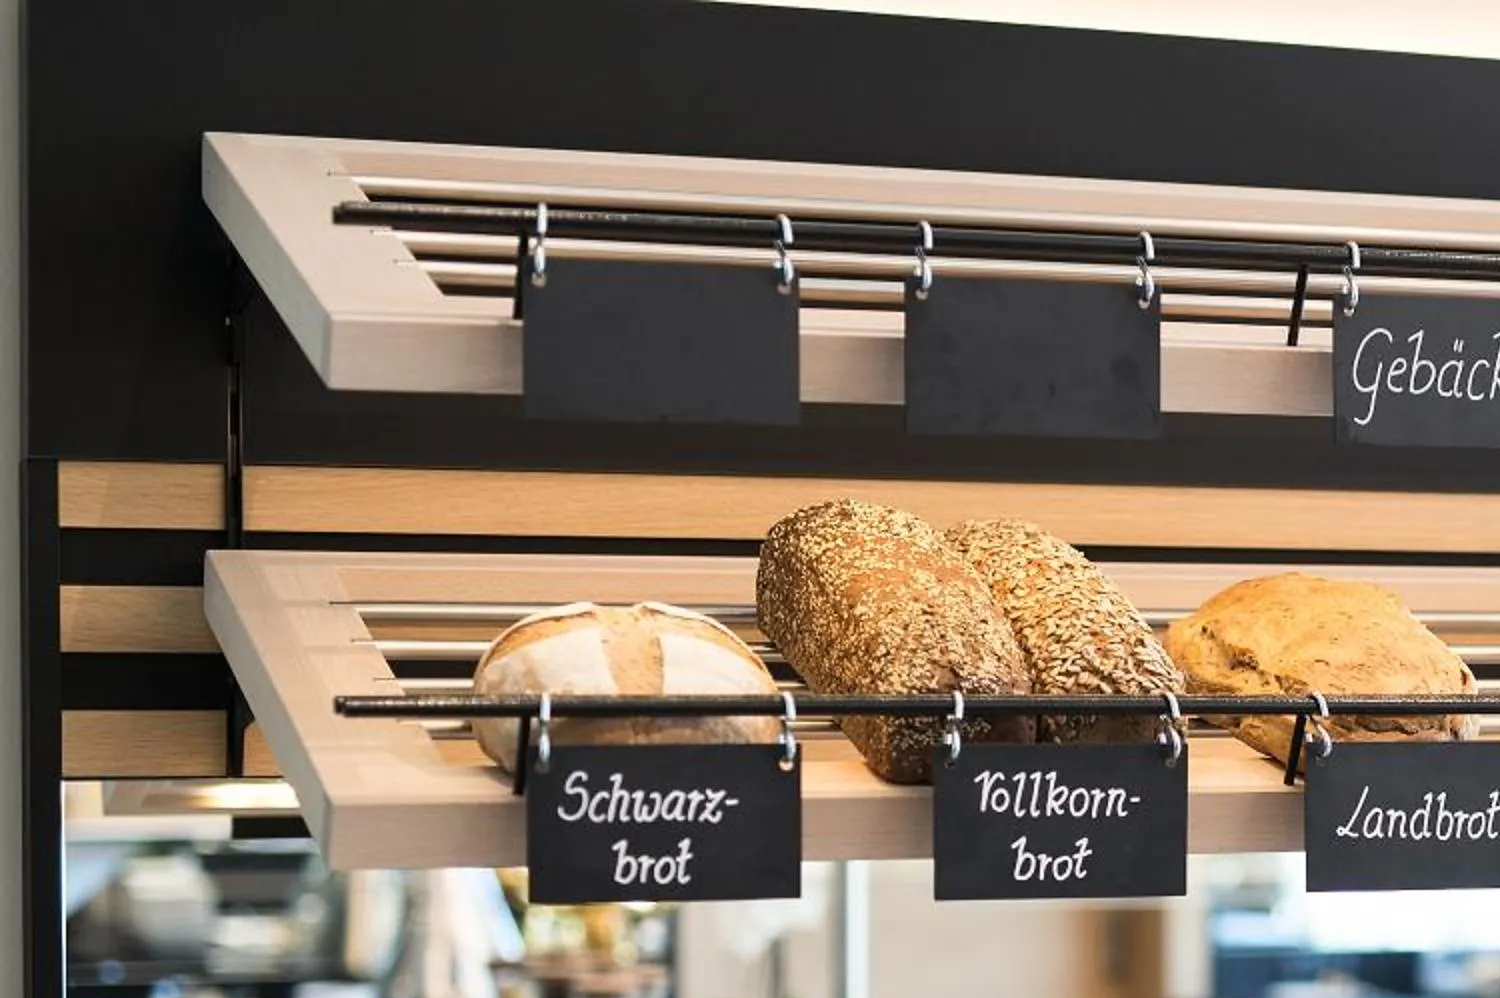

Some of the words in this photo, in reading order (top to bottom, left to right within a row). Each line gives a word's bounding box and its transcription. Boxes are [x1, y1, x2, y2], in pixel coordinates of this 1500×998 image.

[556, 770, 740, 824] Schwarz-
[973, 769, 1141, 819] Vollkorn-
[611, 837, 694, 885] brot
[1010, 835, 1093, 882] brot
